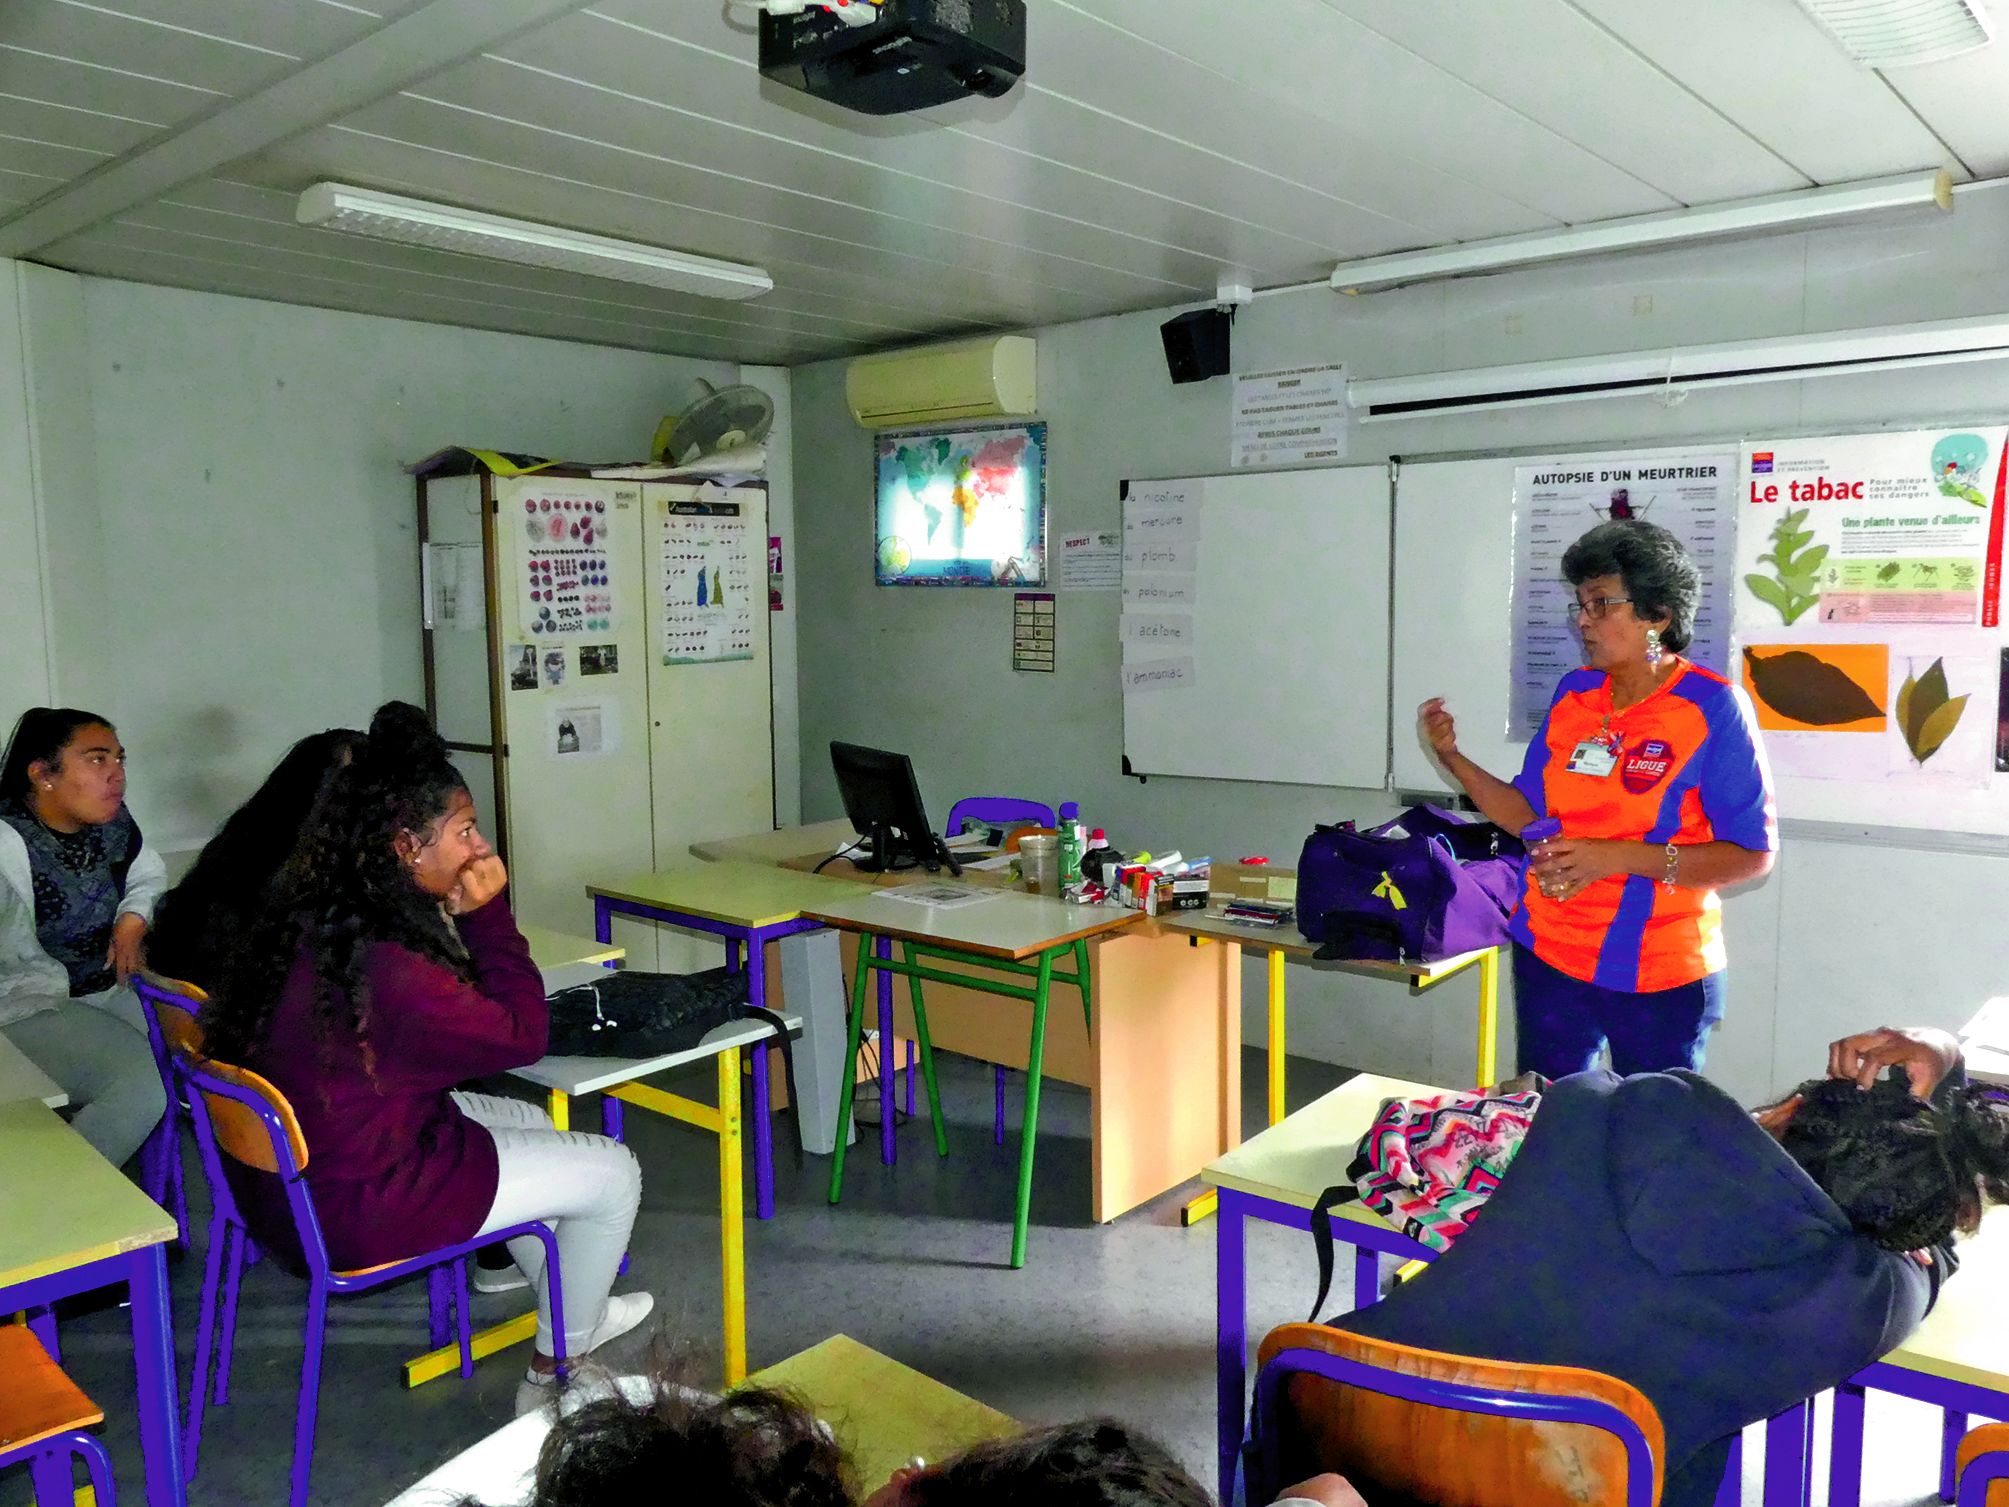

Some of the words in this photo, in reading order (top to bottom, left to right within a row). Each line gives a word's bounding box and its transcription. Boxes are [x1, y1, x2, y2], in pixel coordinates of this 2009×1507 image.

[1532, 472, 1595, 485] AUTOPSIE
[1600, 469, 1632, 482] D'UN
[1638, 466, 1718, 480] MEURTRIER
[1869, 478, 1893, 486] Pour
[1896, 476, 1928, 485] mieux
[1144, 490, 1185, 502] nicotine
[1749, 481, 1779, 504] Le
[1788, 476, 1865, 502] tabac
[1868, 492, 1886, 500] ses
[1887, 491, 1930, 501] dangers
[1841, 517, 1861, 528] Une
[1862, 515, 1896, 529] plante
[1897, 517, 1929, 527] venue
[1931, 514, 1981, 526] d'ailleurs
[1065, 537, 1090, 549] RESPECT
[1141, 546, 1176, 568] plomb
[1138, 583, 1185, 600] polonium
[1626, 759, 1667, 773] LIGUE
